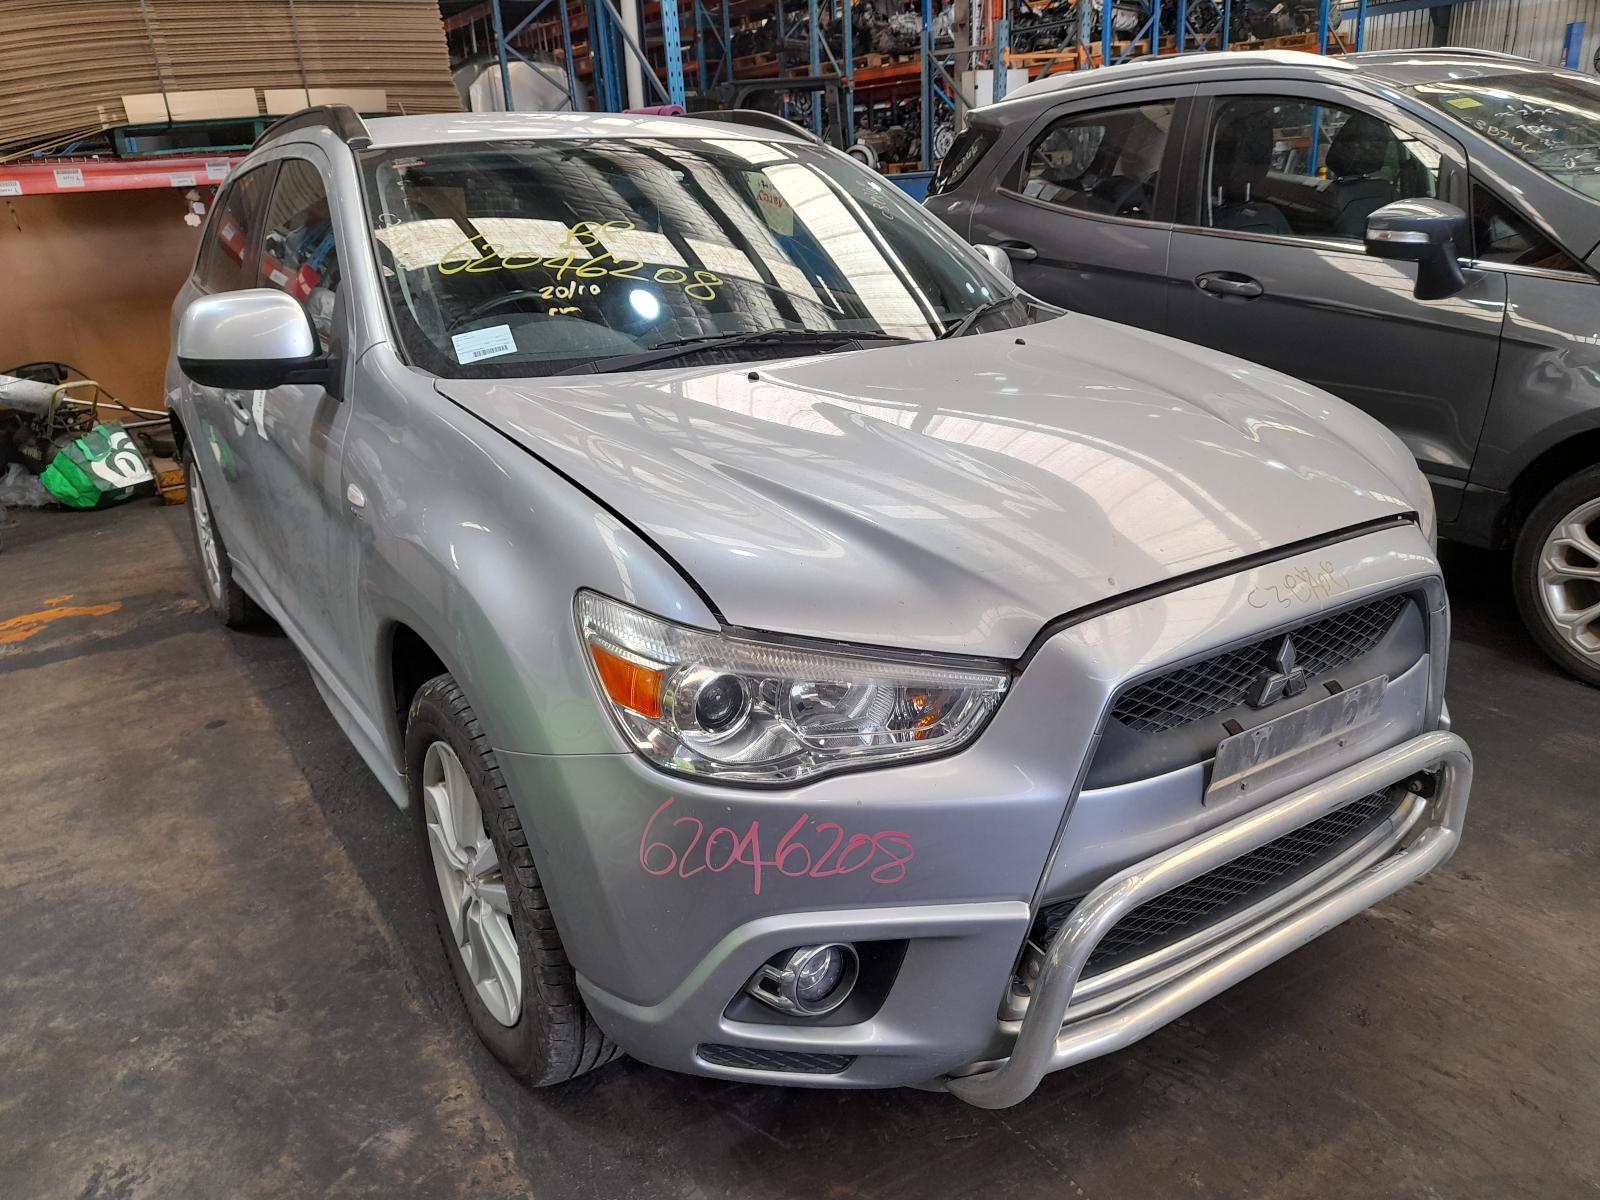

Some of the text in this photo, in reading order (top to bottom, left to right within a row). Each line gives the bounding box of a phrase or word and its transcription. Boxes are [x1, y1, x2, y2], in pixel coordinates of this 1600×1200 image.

[438, 231, 724, 301] 62046208
[538, 280, 601, 300] 20/10
[639, 796, 916, 896] 62046208
